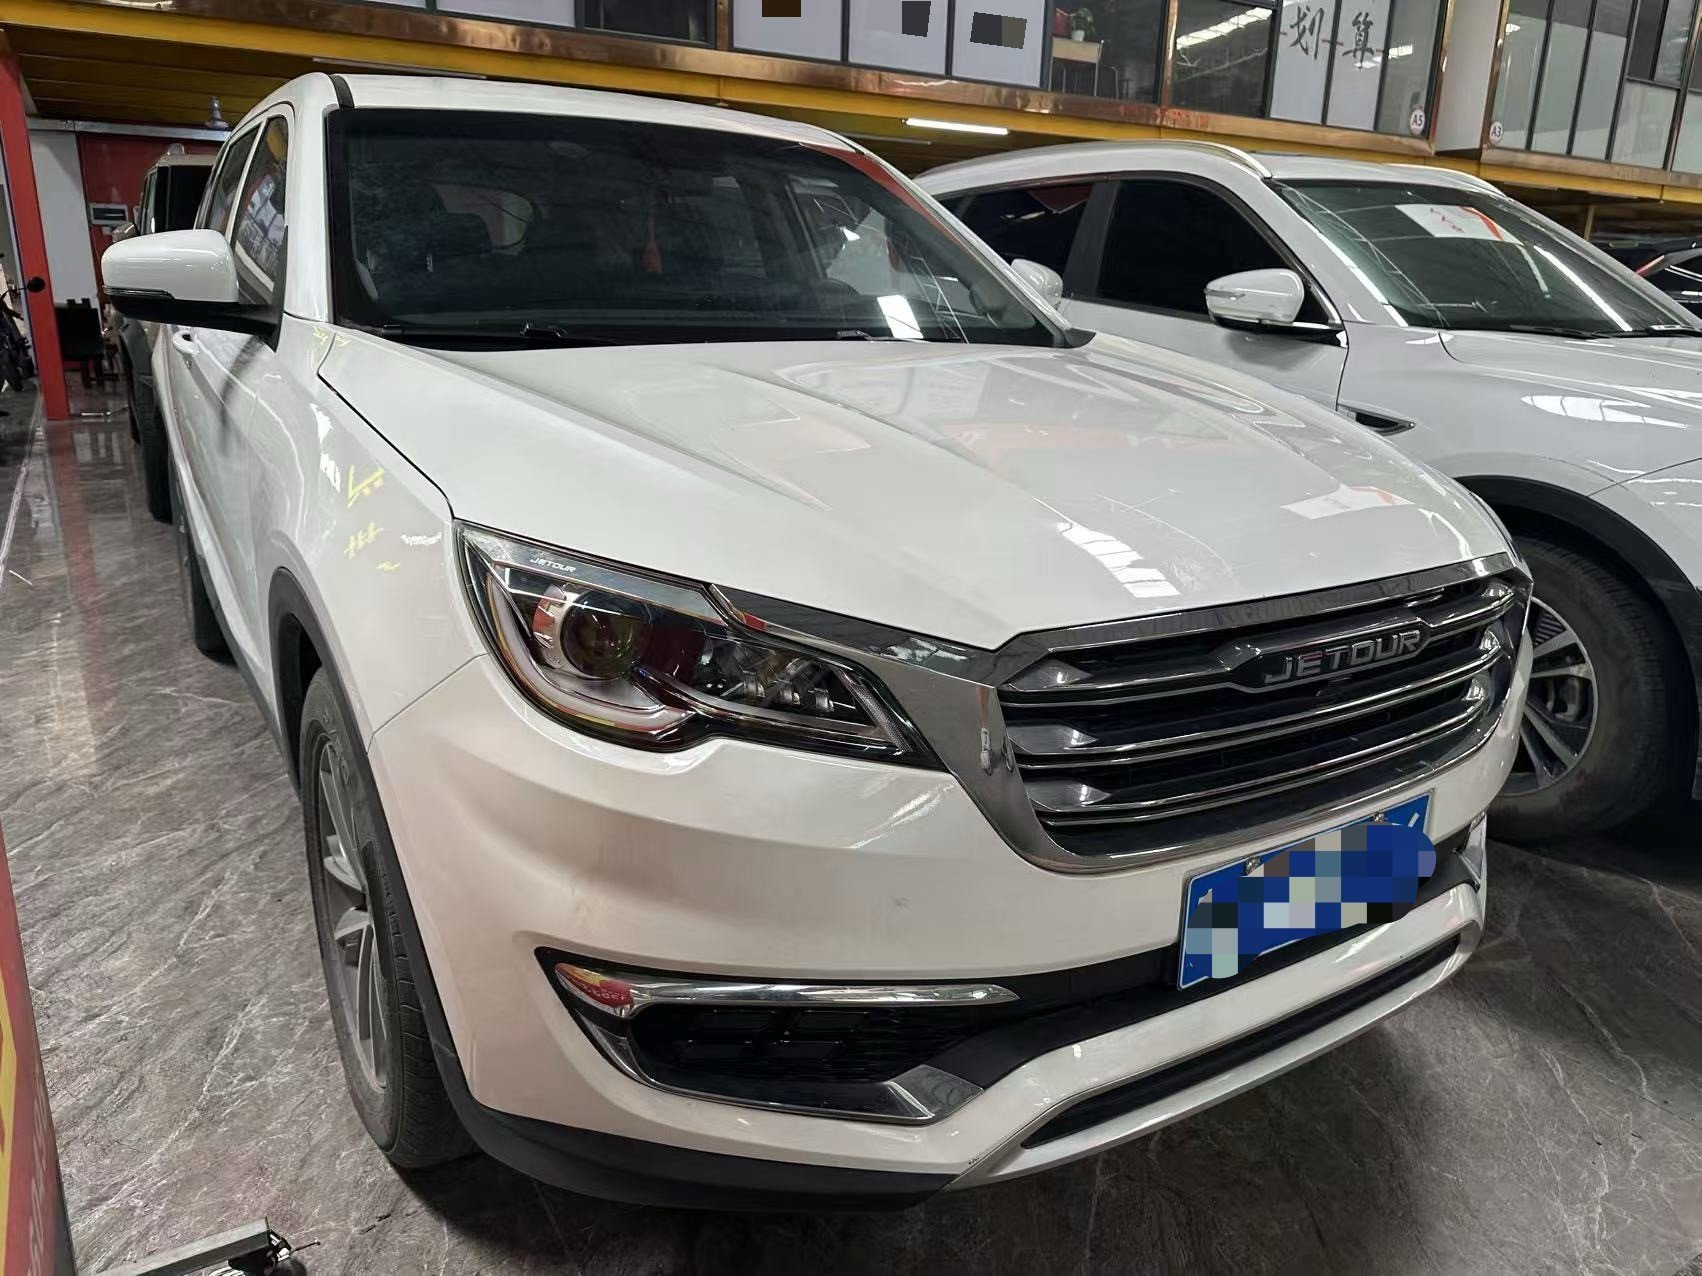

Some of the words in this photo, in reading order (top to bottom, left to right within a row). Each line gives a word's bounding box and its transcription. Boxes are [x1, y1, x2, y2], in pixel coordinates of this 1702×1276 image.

[1411, 114, 1423, 127] A5
[529, 557, 577, 573] JETOUR
[1264, 629, 1421, 684] JETOUR
